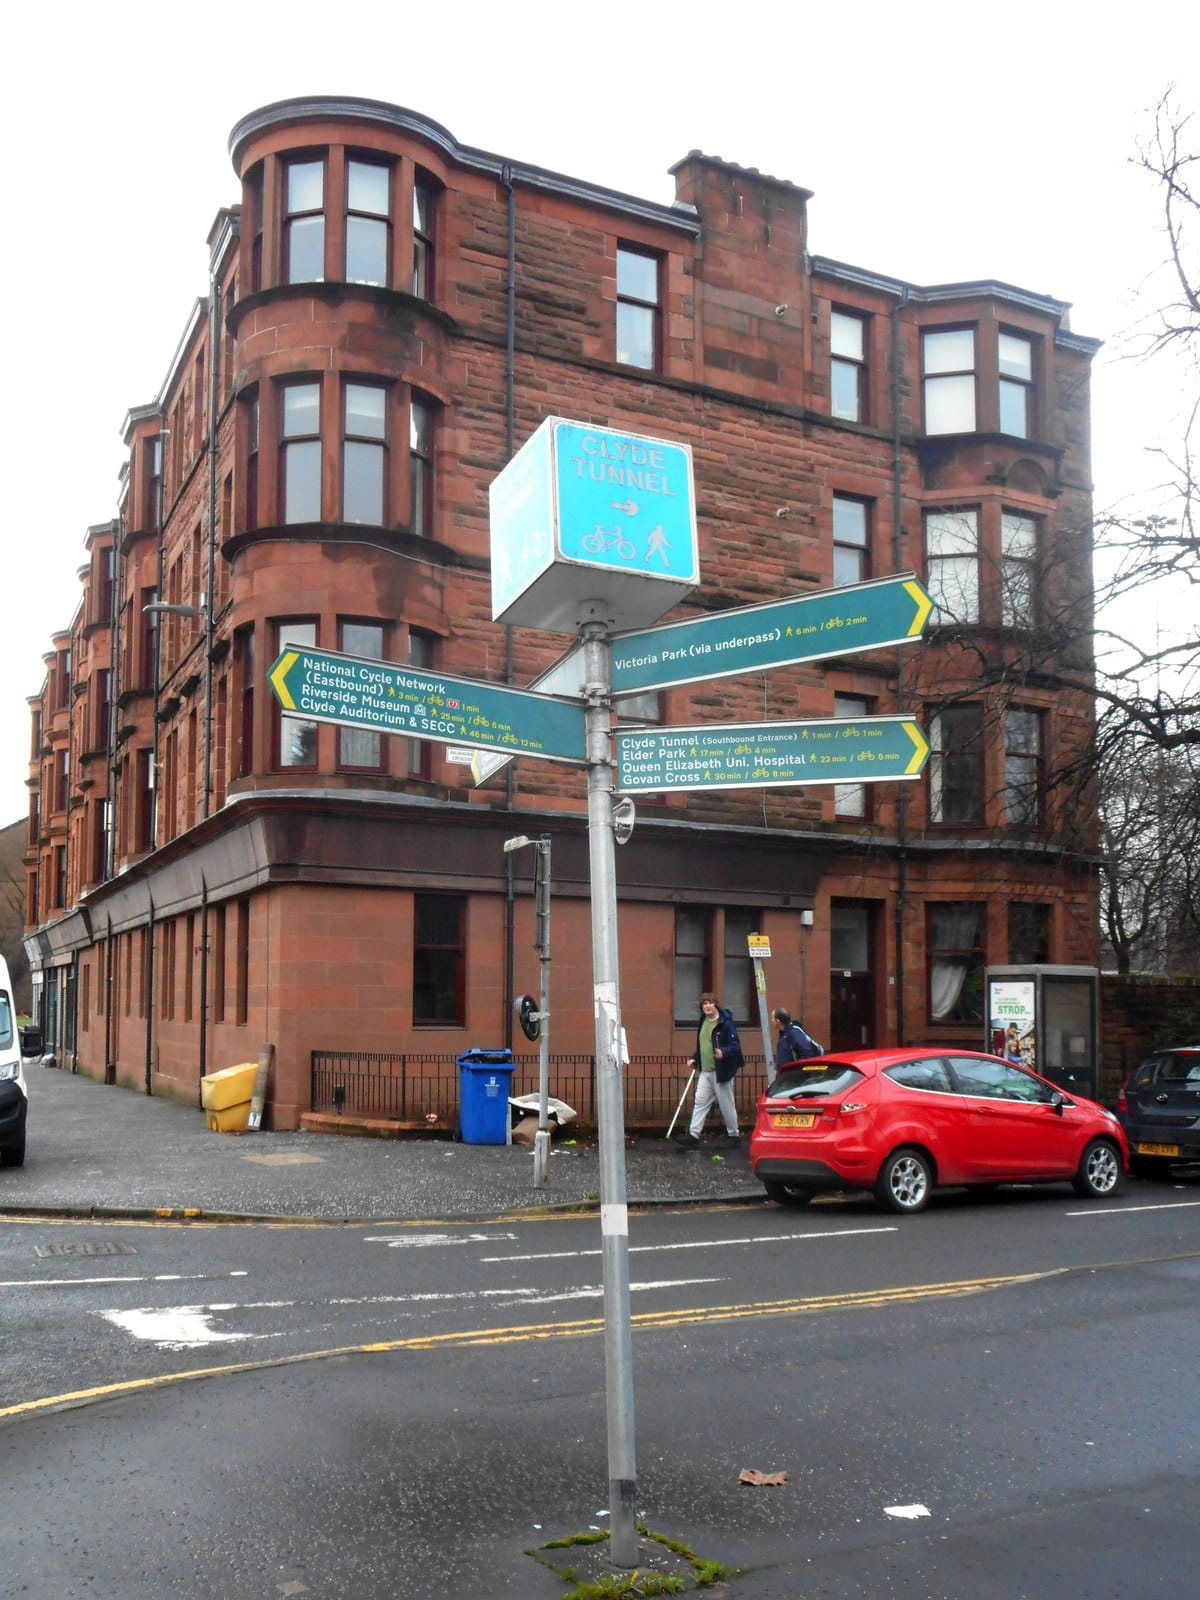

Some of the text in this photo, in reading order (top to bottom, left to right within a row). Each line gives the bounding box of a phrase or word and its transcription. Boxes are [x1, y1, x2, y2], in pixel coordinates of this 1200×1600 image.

[581, 436, 665, 470] CLYDE
[570, 457, 678, 497] TUNNEL
[615, 654, 658, 670] Victoria
[662, 648, 687, 661] Park
[690, 645, 712, 657] (via
[715, 628, 781, 650] underpass)
[304, 657, 446, 694] National Cycle Network
[306, 671, 384, 696] (Eastbound)
[302, 684, 357, 704] Riverside
[362, 696, 410, 713] Museum
[301, 698, 336, 713] Clyde
[340, 704, 405, 726] Auditorium
[409, 716, 417, 728] &
[421, 719, 455, 734] SECC
[622, 738, 656, 749] Clyde
[660, 736, 699, 747] Tunnel
[702, 736, 755, 746] (Southbound
[758, 733, 798, 743] Entrance)
[623, 751, 653, 761] Elder
[659, 749, 686, 758] Park
[623, 763, 661, 773] Queen
[666, 759, 721, 770] Elizabeth
[726, 757, 749, 768] Uni.
[754, 755, 806, 767] Hospital
[623, 775, 661, 785] Govan
[665, 773, 699, 783] Cross
[998, 1005, 1025, 1014] STROP
